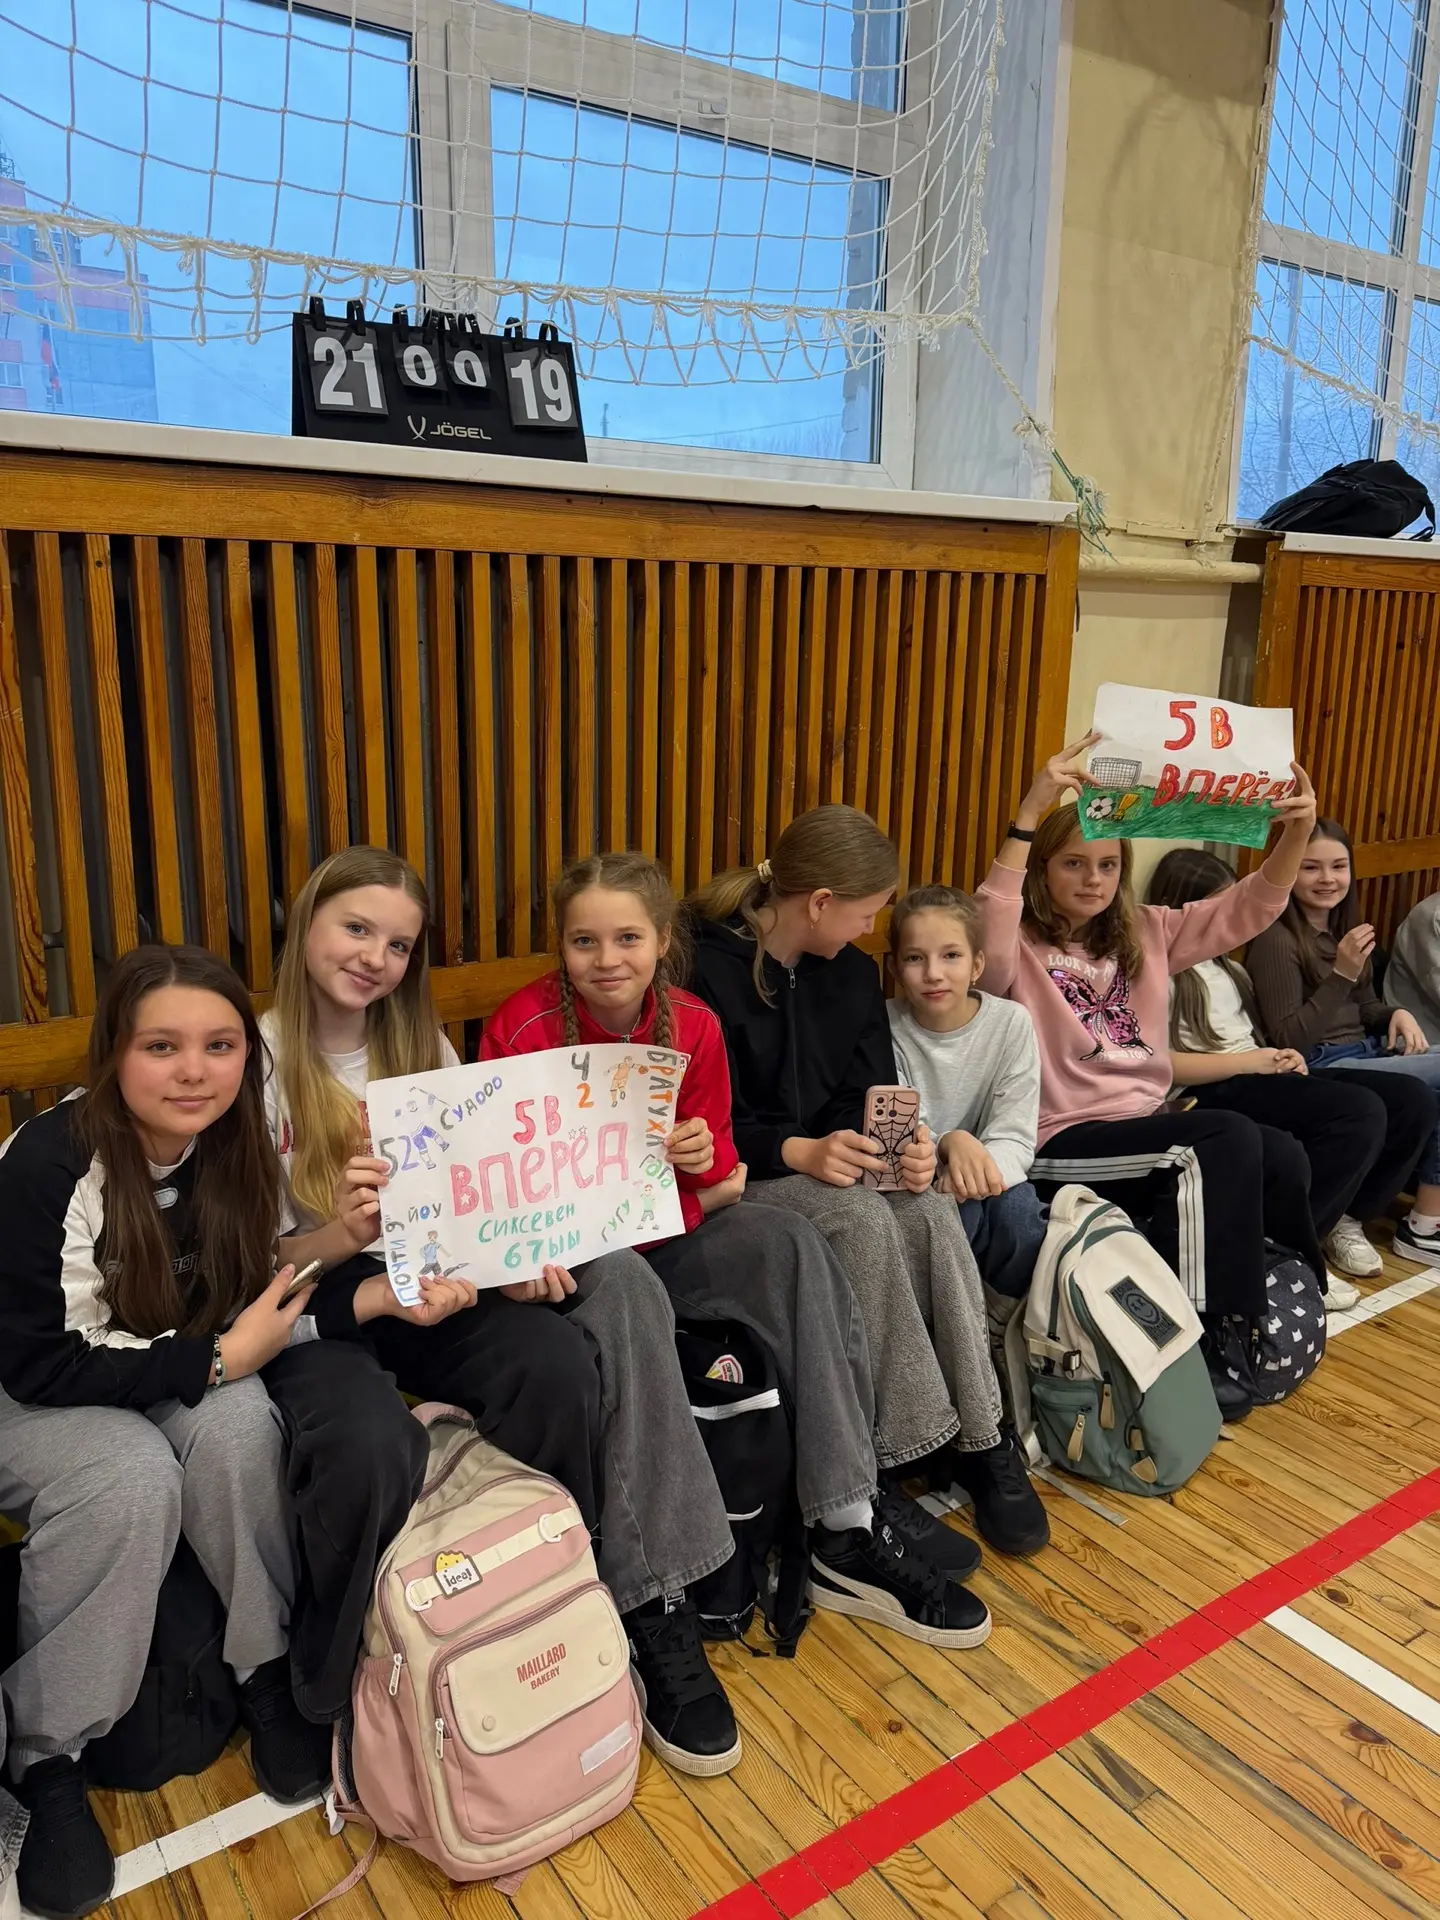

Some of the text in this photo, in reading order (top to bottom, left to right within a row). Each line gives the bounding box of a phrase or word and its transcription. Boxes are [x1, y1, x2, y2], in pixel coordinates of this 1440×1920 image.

[313, 336, 383, 409] 21
[510, 358, 573, 422] 19
[430, 421, 492, 441] JÖGEL
[1047, 954, 1080, 971] LOOK
[1083, 963, 1098, 980] AT
[379, 1135, 419, 1180] 52
[516, 1642, 567, 1684] MAILLARD
[530, 1665, 561, 1690] BAKERY
